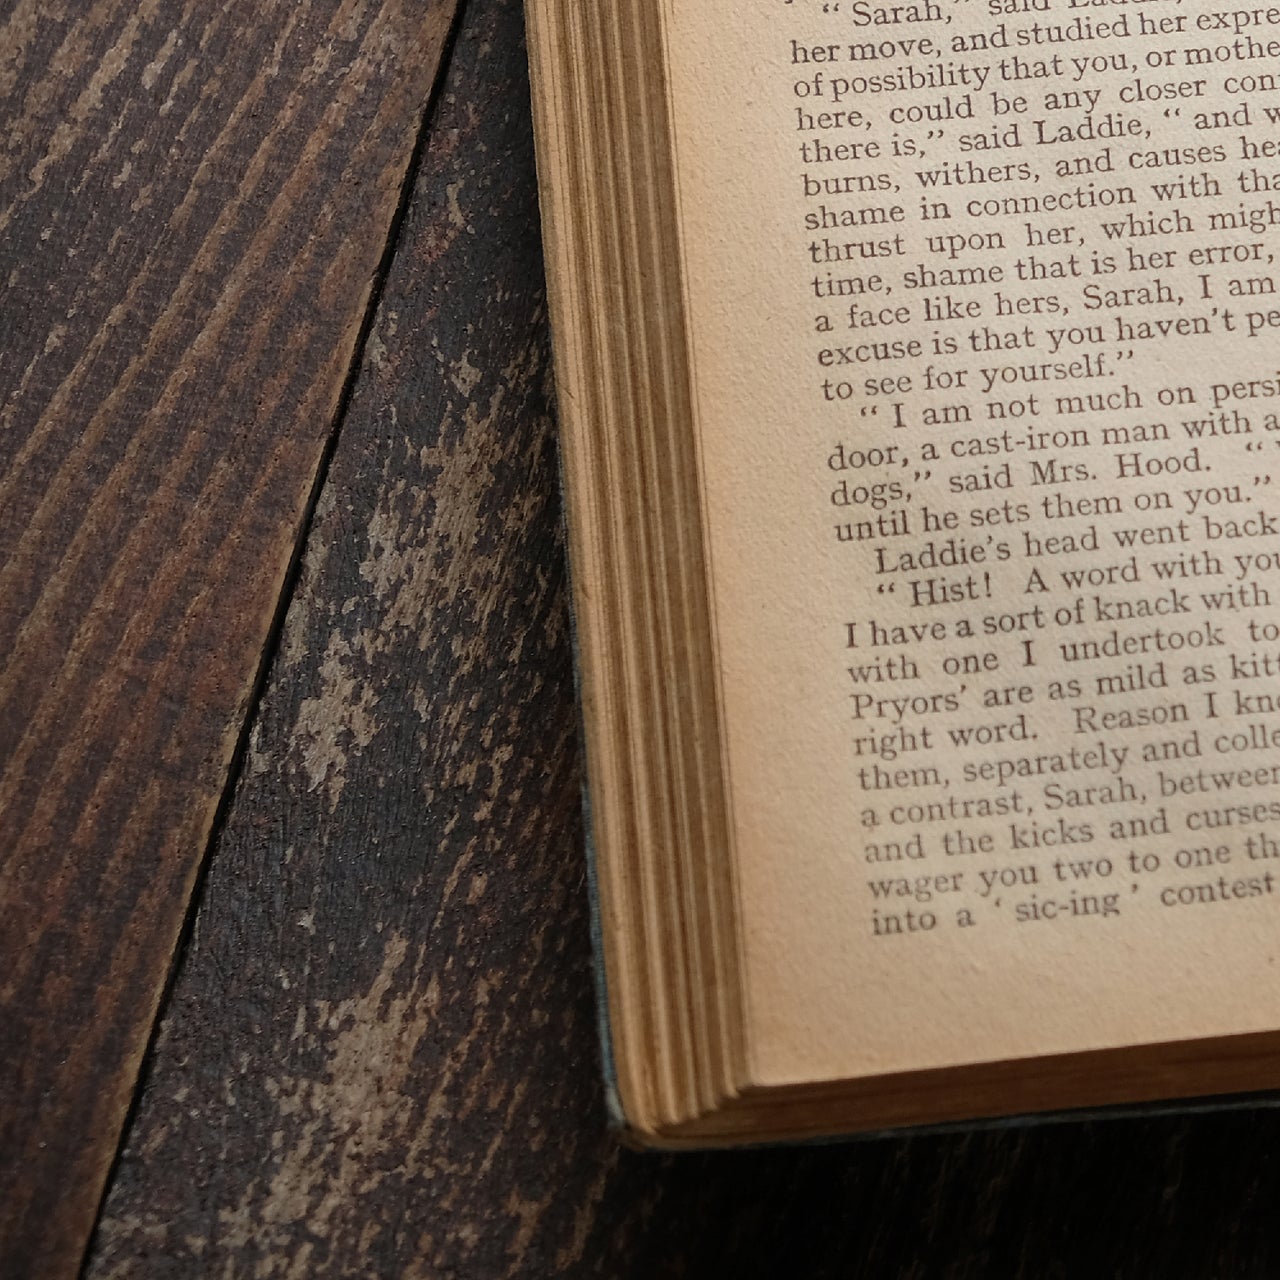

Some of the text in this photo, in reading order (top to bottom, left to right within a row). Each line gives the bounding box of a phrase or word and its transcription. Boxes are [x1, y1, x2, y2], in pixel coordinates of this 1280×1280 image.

[806, 232, 908, 265] thrust
[923, 231, 1008, 261] upon
[1023, 221, 1086, 248] her,
[1099, 207, 1196, 242] which
[826, 441, 910, 473] door,
[919, 441, 942, 462] a
[949, 429, 1092, 459] cast-iron
[1100, 422, 1172, 446] man
[1179, 408, 1254, 440] with
[1021, 524, 1101, 559] head
[1111, 518, 1191, 549] went
[1201, 509, 1280, 541] back
[867, 872, 965, 899] wager
[977, 864, 1040, 892] you
[1052, 857, 1114, 883] two
[1127, 850, 1162, 875] to
[1173, 844, 1231, 869] one
